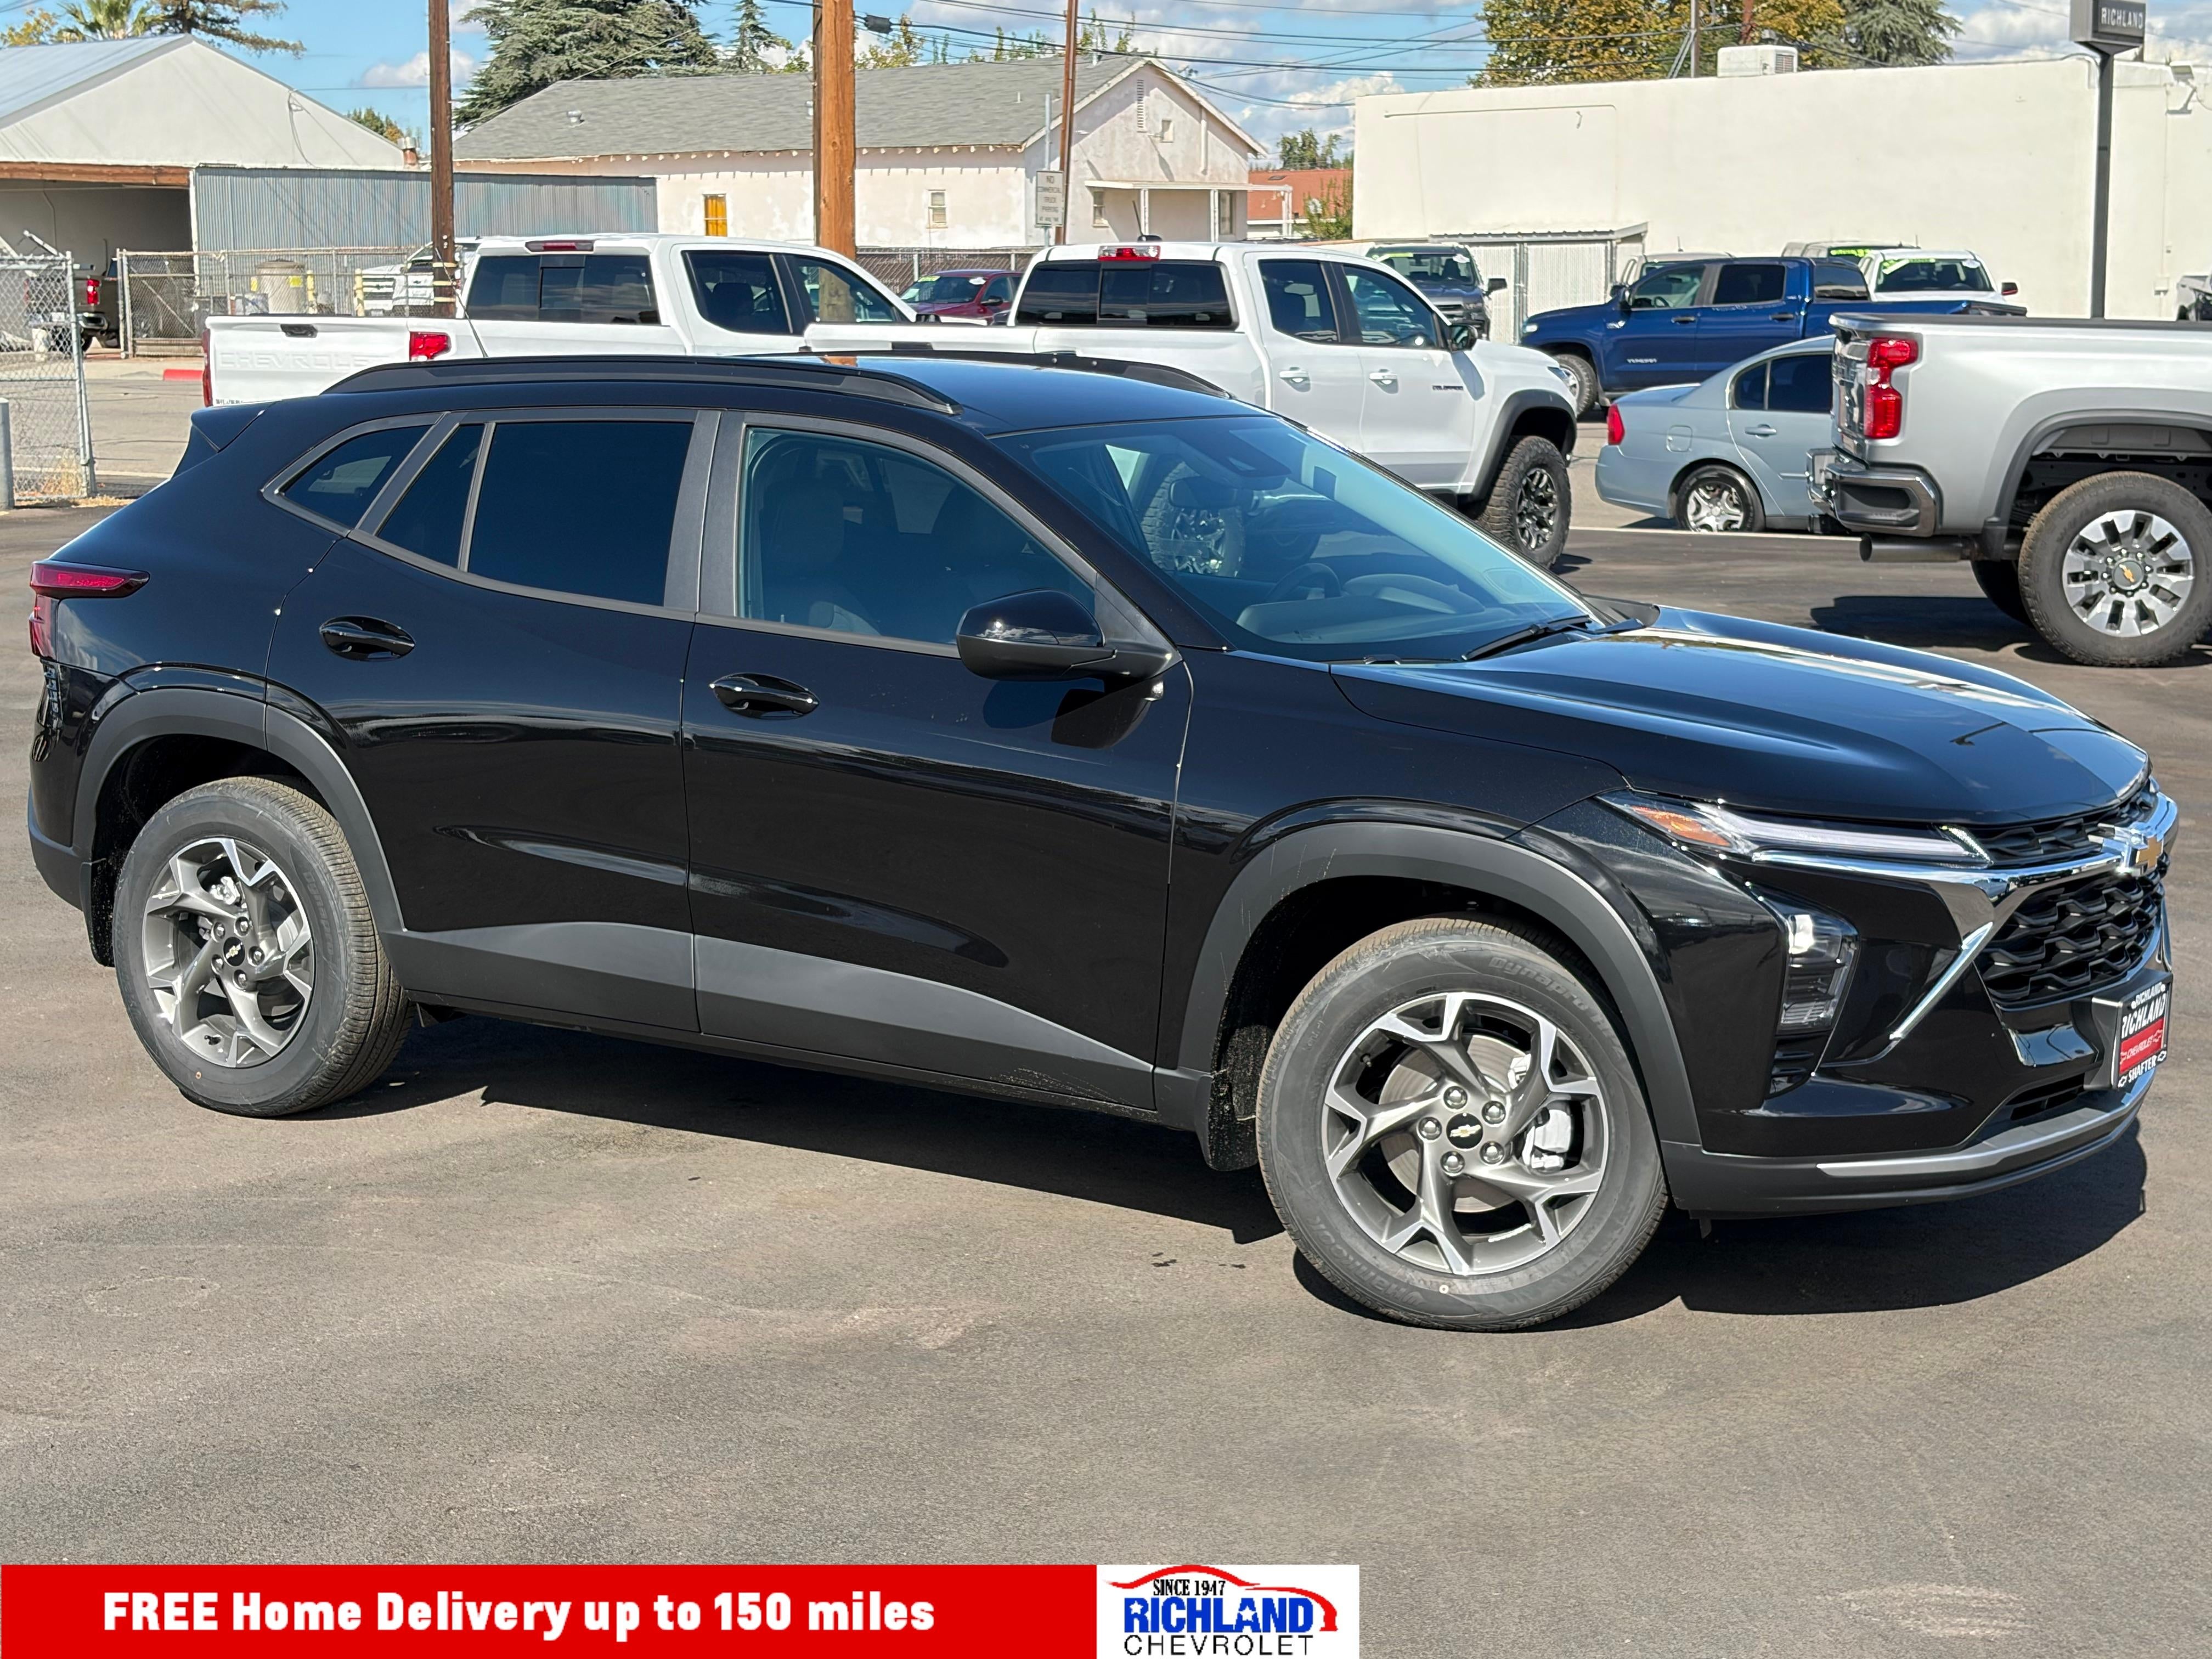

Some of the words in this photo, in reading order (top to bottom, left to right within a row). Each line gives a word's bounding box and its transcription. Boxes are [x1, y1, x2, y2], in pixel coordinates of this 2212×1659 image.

[2101, 7, 2143, 30] RICHLAND
[1488, 957, 1589, 1011] Dynapro
[2121, 993, 2166, 1039] RICHLAND
[2128, 1055, 2157, 1084] SHAFTER
